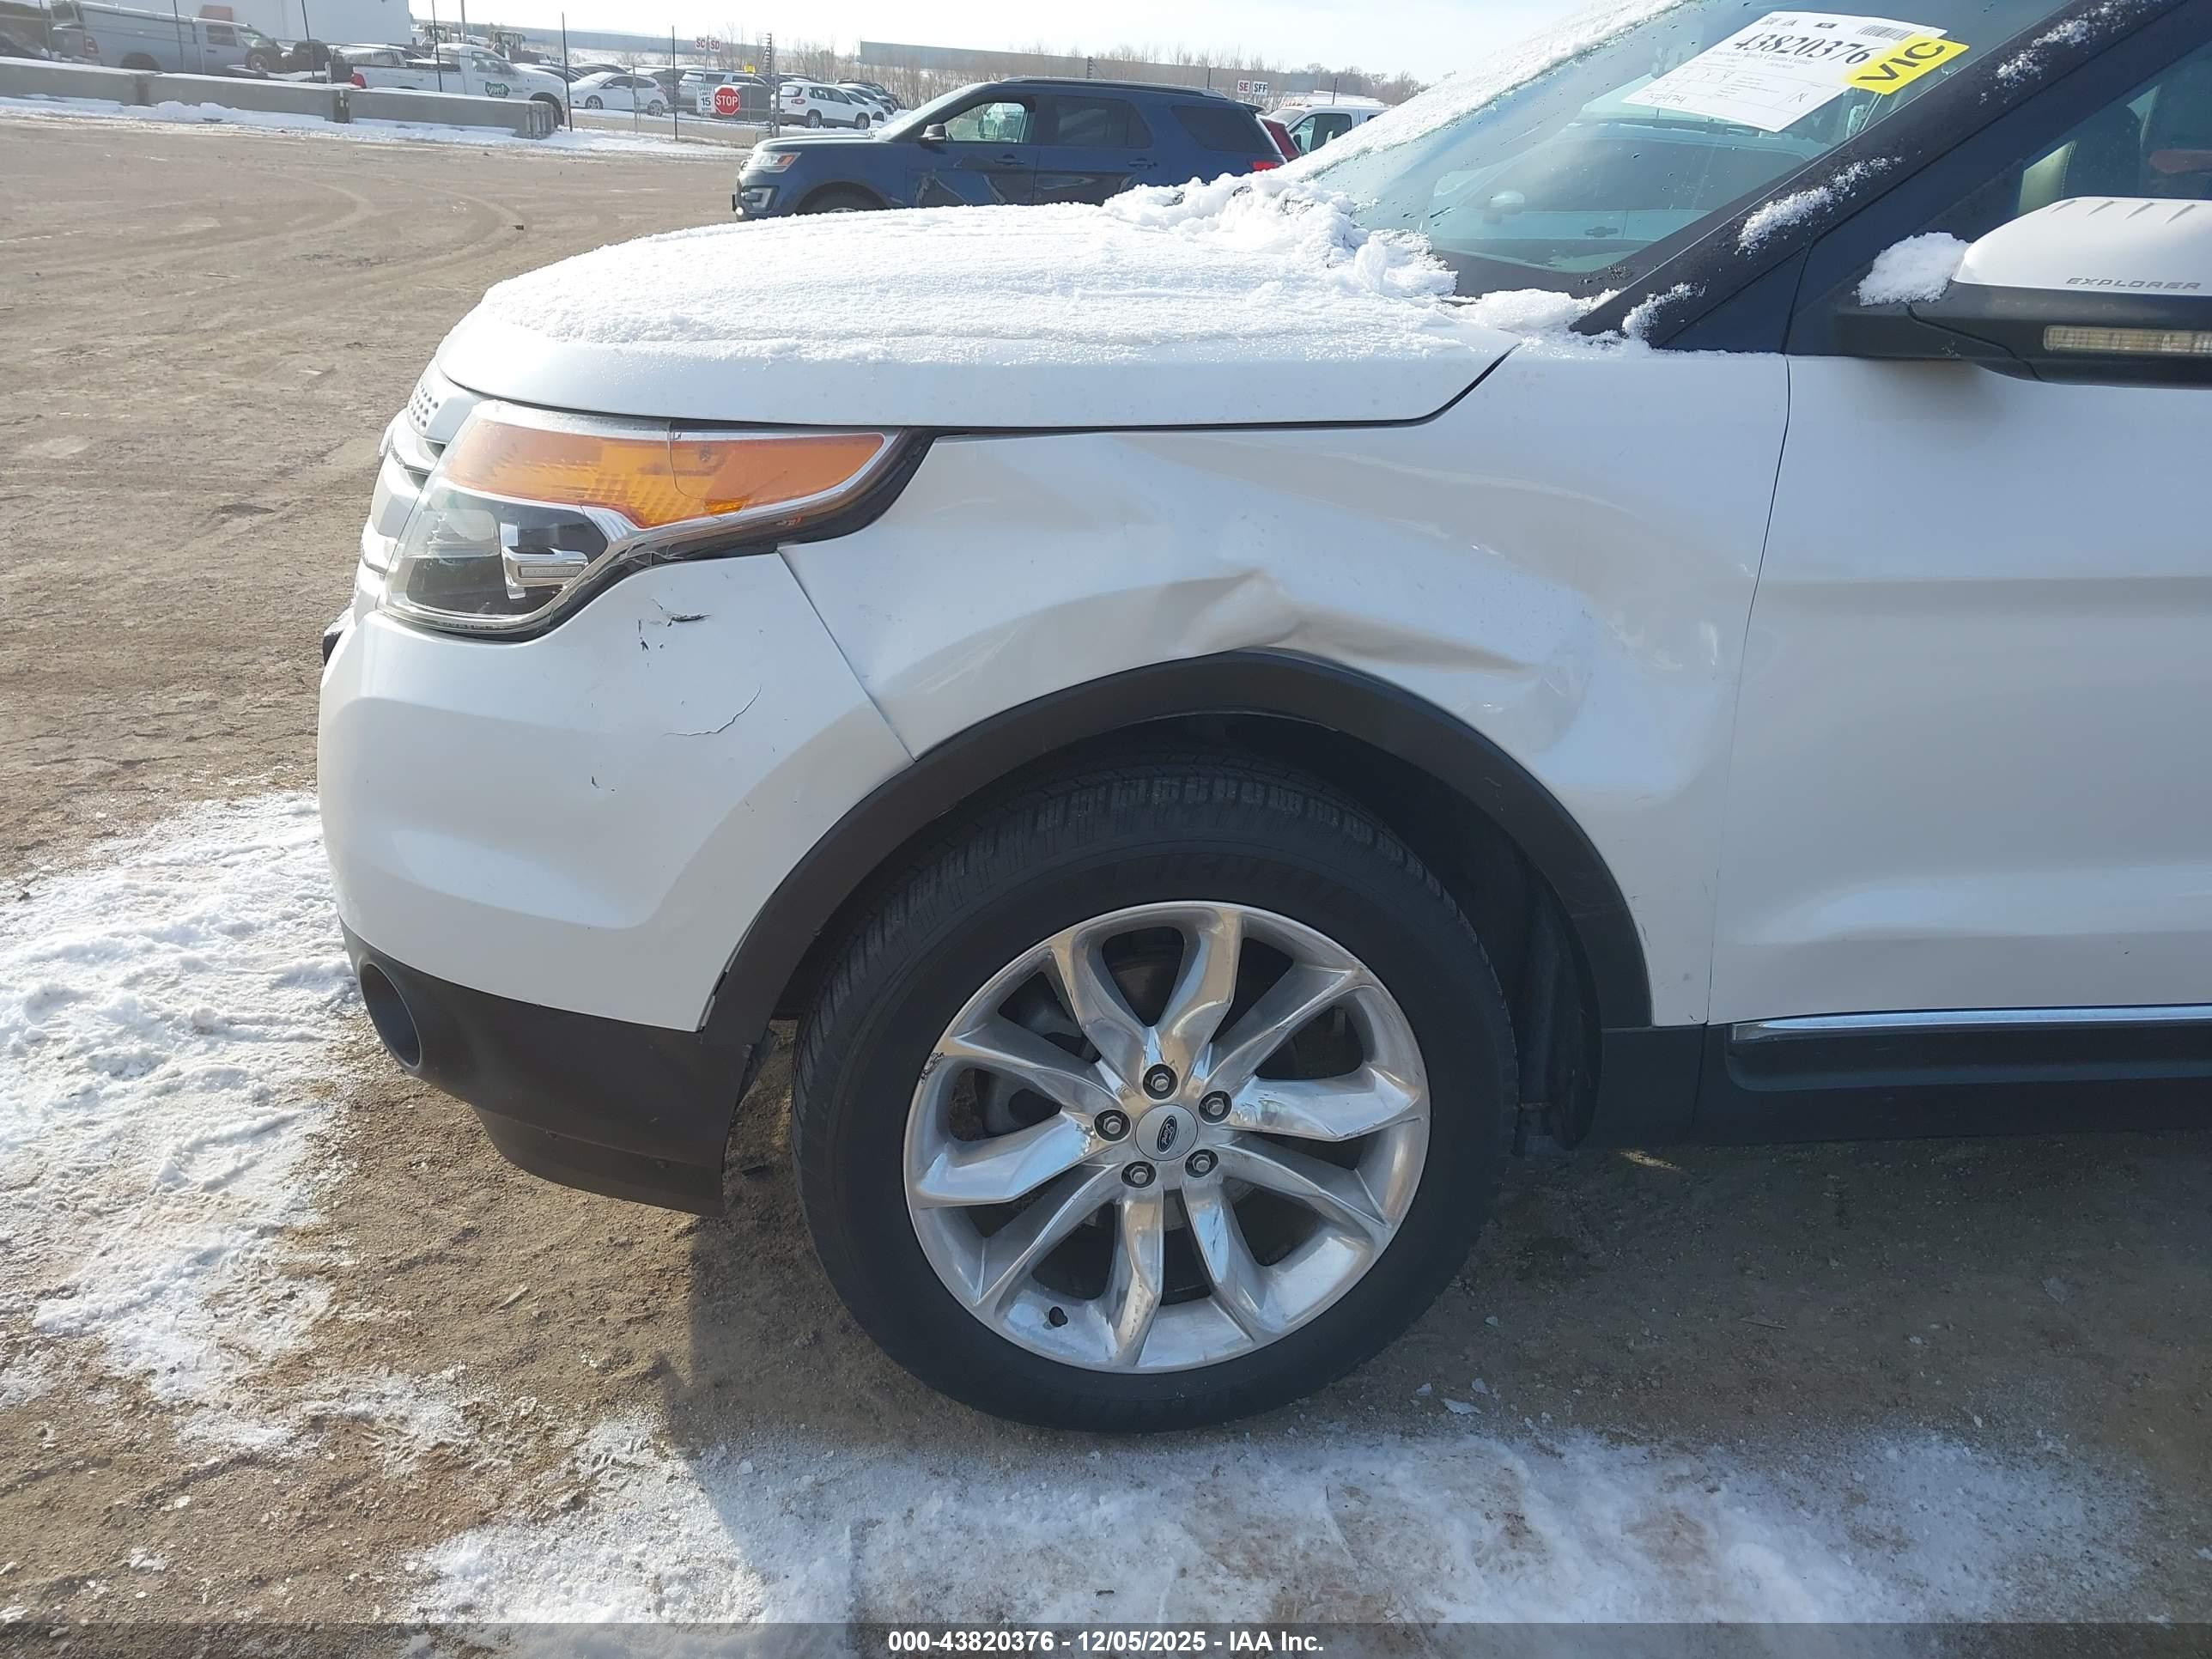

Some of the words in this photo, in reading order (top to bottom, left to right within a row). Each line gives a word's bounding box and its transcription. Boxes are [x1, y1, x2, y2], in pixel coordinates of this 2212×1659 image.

[696, 39, 705, 48] SC
[710, 40, 720, 50] SD
[1733, 33, 1886, 64] 43820376
[1856, 41, 1945, 81] VIC
[1239, 82, 1249, 92] SE
[1254, 83, 1267, 93] SFF
[701, 96, 711, 106] 15
[715, 94, 738, 106] STOP
[2066, 277, 2201, 289] EXPLORER
[1160, 1122, 1175, 1146] Ford
